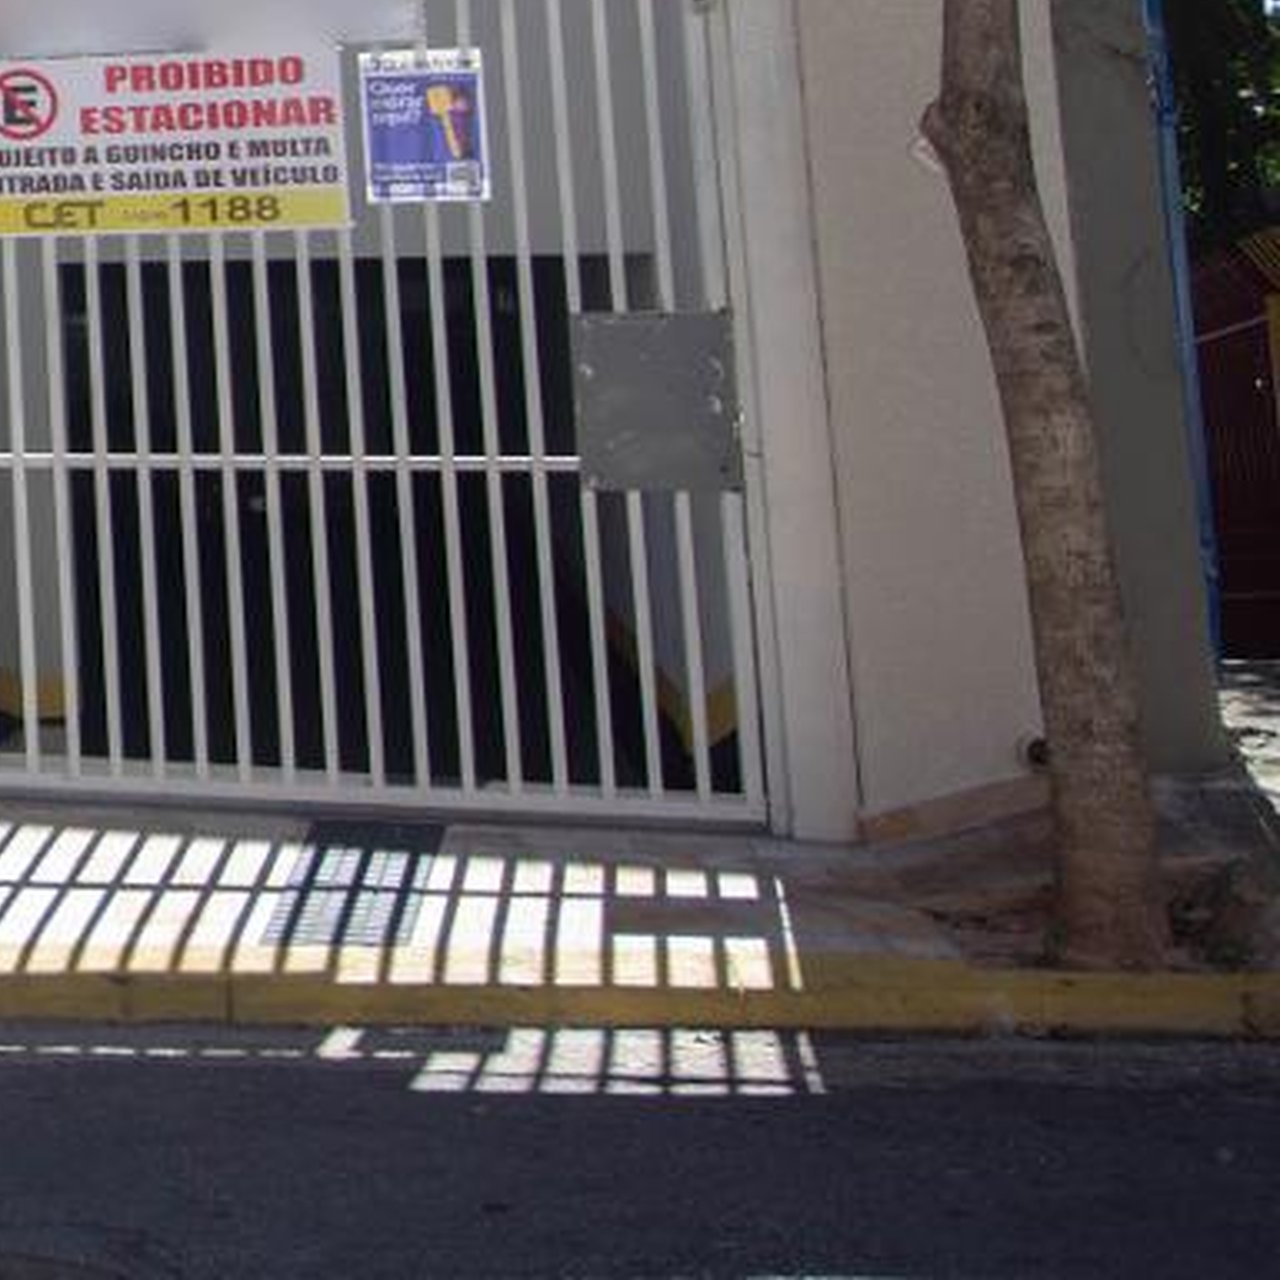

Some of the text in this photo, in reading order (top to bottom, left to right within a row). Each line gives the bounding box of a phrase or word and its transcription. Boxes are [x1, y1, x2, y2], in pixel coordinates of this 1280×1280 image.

[103, 56, 305, 93] PROIBIDO
[79, 96, 337, 135] ESTACIONAR
[83, 145, 99, 164] A
[106, 140, 221, 164] GUINCHO
[227, 140, 242, 160] E
[247, 136, 331, 158] MULTA
[92, 172, 105, 191] E
[194, 168, 226, 188] DE
[23, 199, 104, 229] CET
[170, 194, 281, 224] 1188
